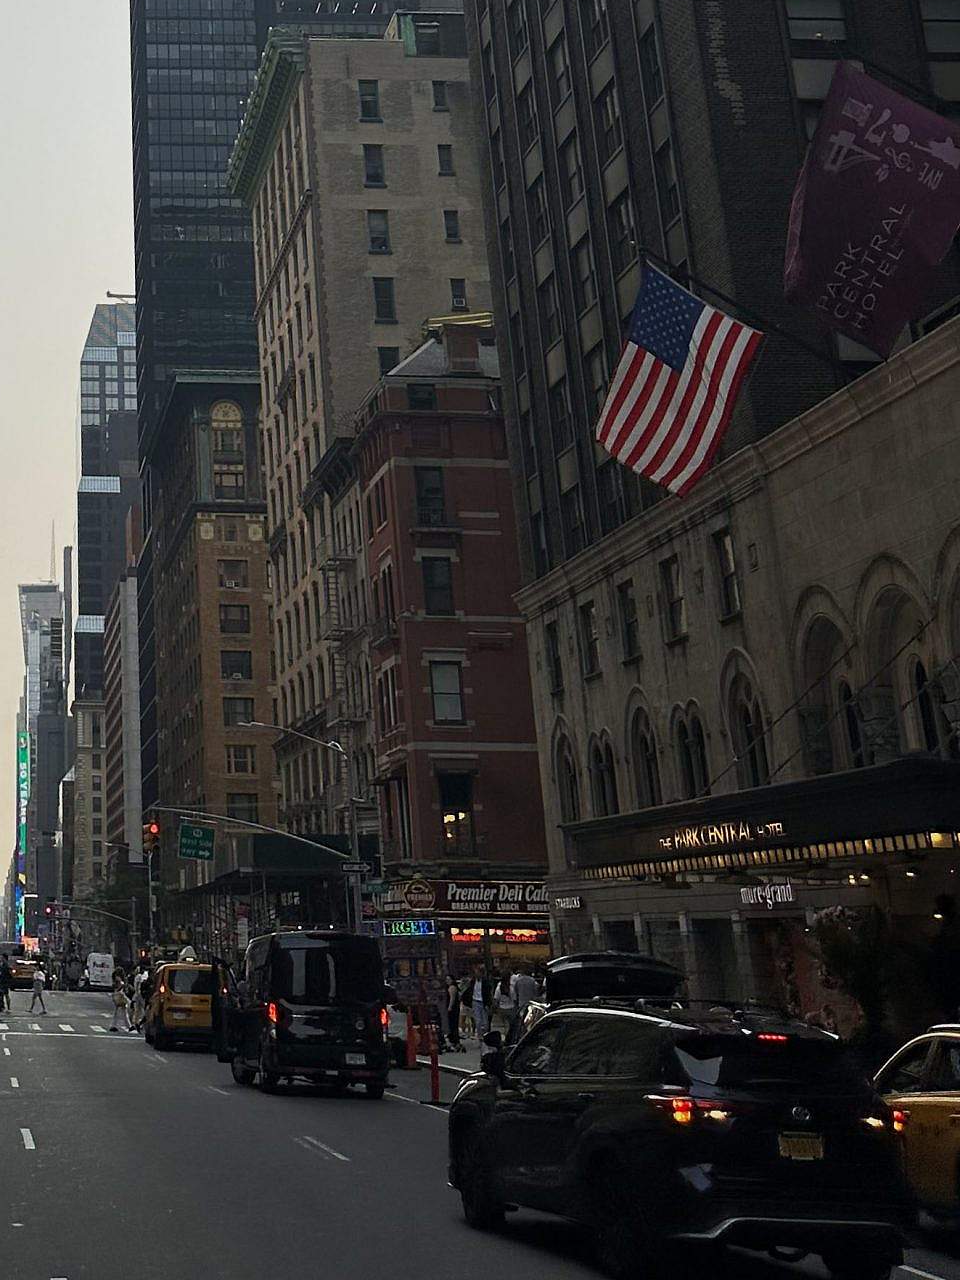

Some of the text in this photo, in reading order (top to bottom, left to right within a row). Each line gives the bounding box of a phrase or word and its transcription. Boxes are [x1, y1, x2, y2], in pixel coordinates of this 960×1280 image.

[816, 242, 862, 311] PARK
[833, 203, 907, 319] CENTRAL
[853, 248, 905, 329] HOTEL
[659, 822, 787, 850] THE PARK CENTRAL HOTEL
[447, 883, 497, 901] Premier
[499, 884, 524, 901] Deli
[451, 901, 491, 911] BREAKFAST
